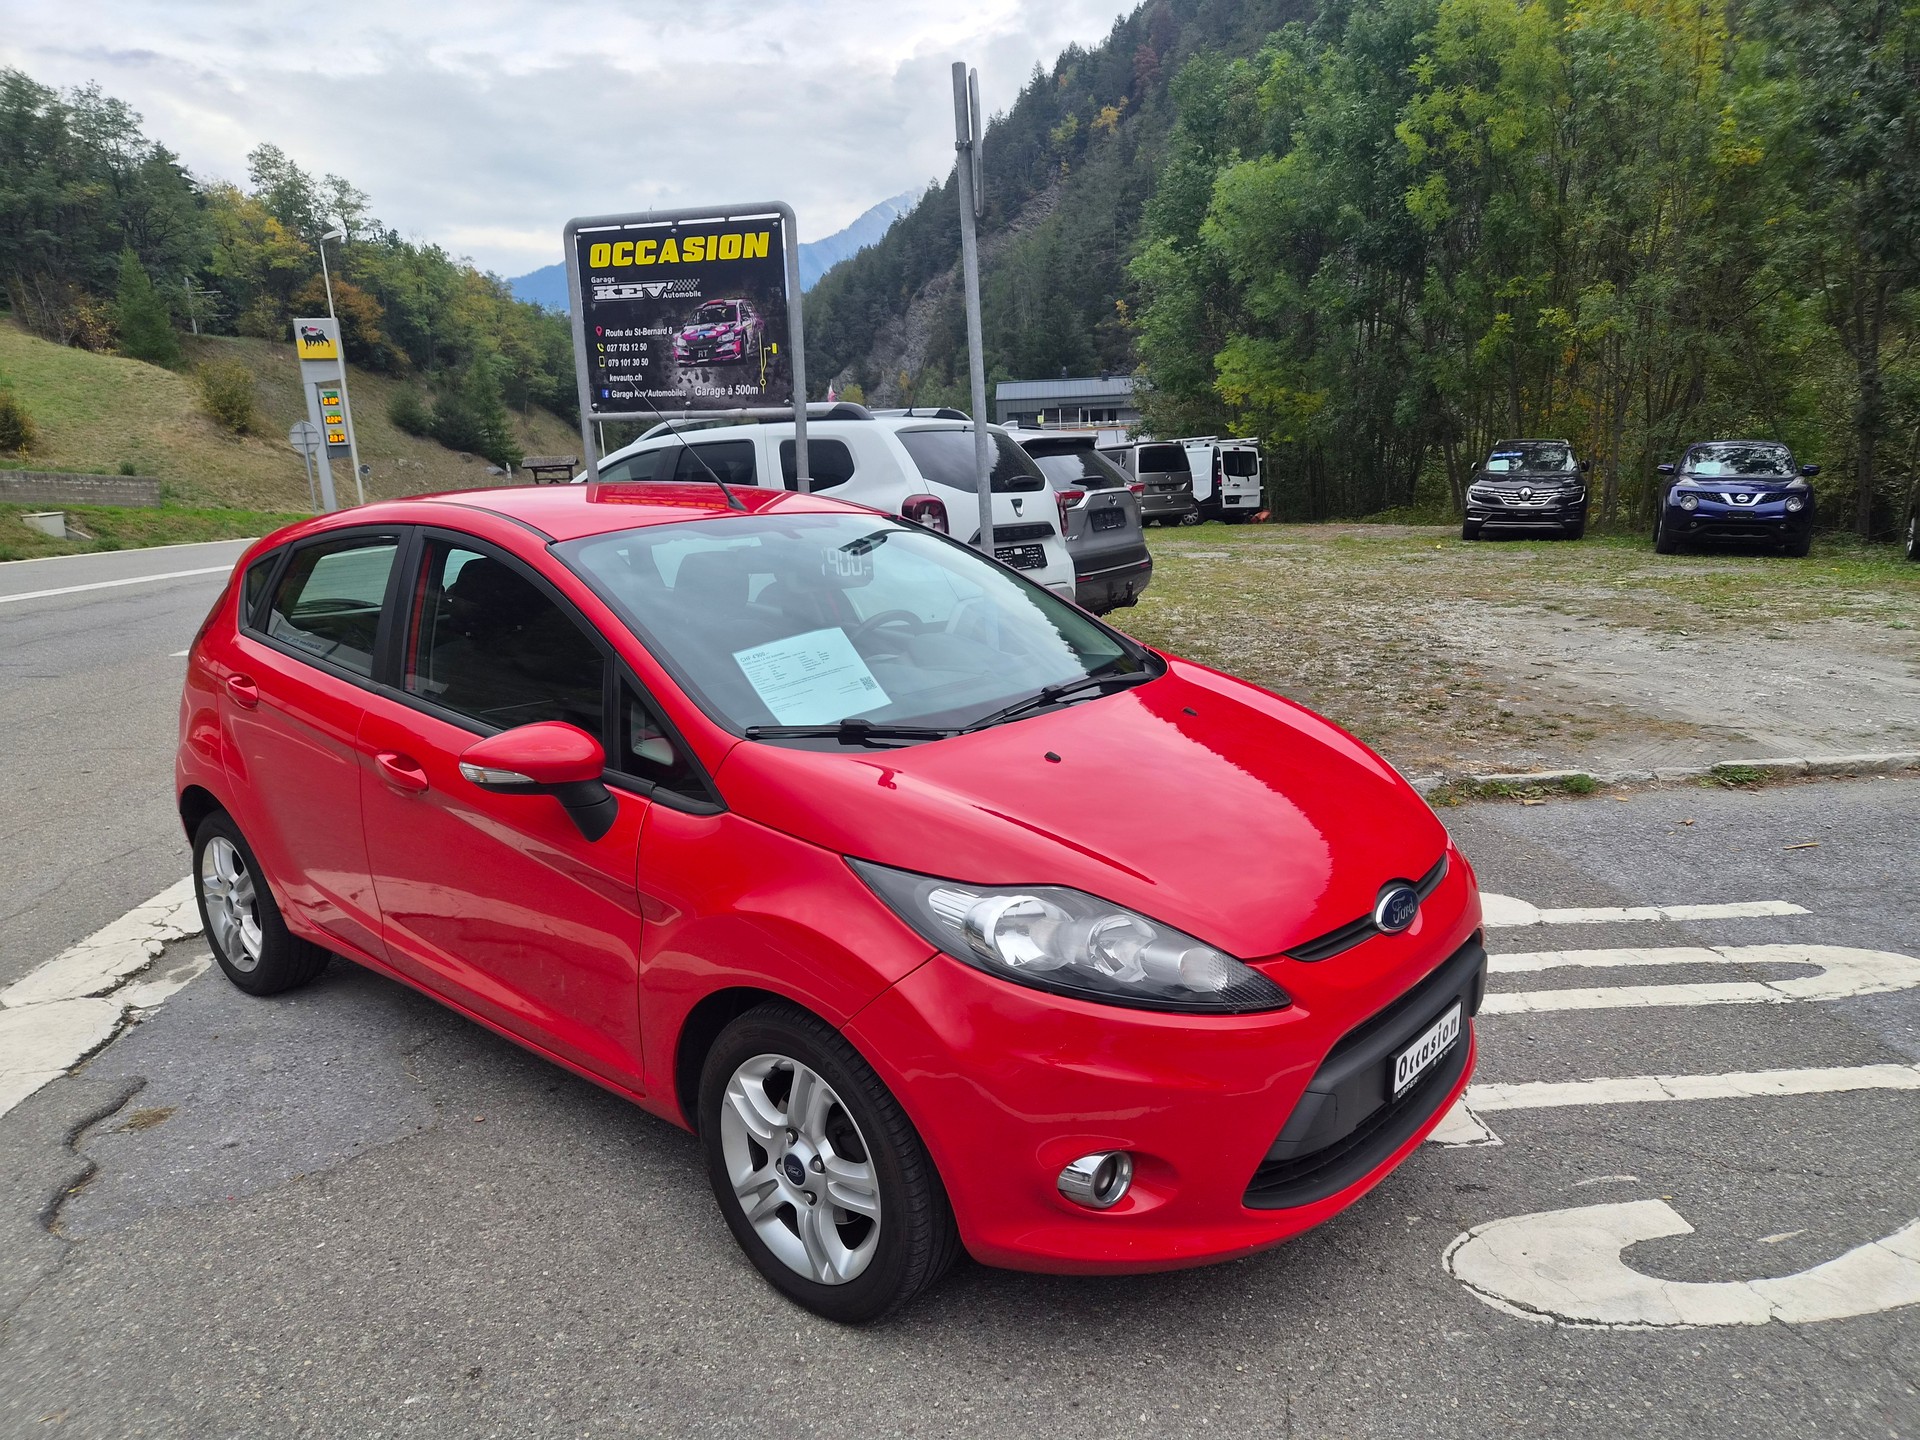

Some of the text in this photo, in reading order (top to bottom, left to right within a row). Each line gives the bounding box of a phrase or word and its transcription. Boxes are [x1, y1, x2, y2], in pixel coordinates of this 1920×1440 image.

[590, 231, 770, 268] OCCASION
[591, 276, 615, 284] Garage
[663, 290, 702, 299] Automobile
[605, 329, 624, 337] Route
[625, 328, 632, 336] du
[634, 327, 667, 336] St-Bernard
[606, 343, 648, 352] 027 783 12 50
[607, 359, 619, 367] 079
[620, 359, 631, 367] 101
[641, 358, 649, 366] 50
[609, 374, 643, 382] kevauto.ch
[611, 390, 633, 399] Garage
[695, 384, 759, 398] Garage à 500m
[1392, 896, 1415, 924] Ford
[1398, 1015, 1457, 1083] Occasion
